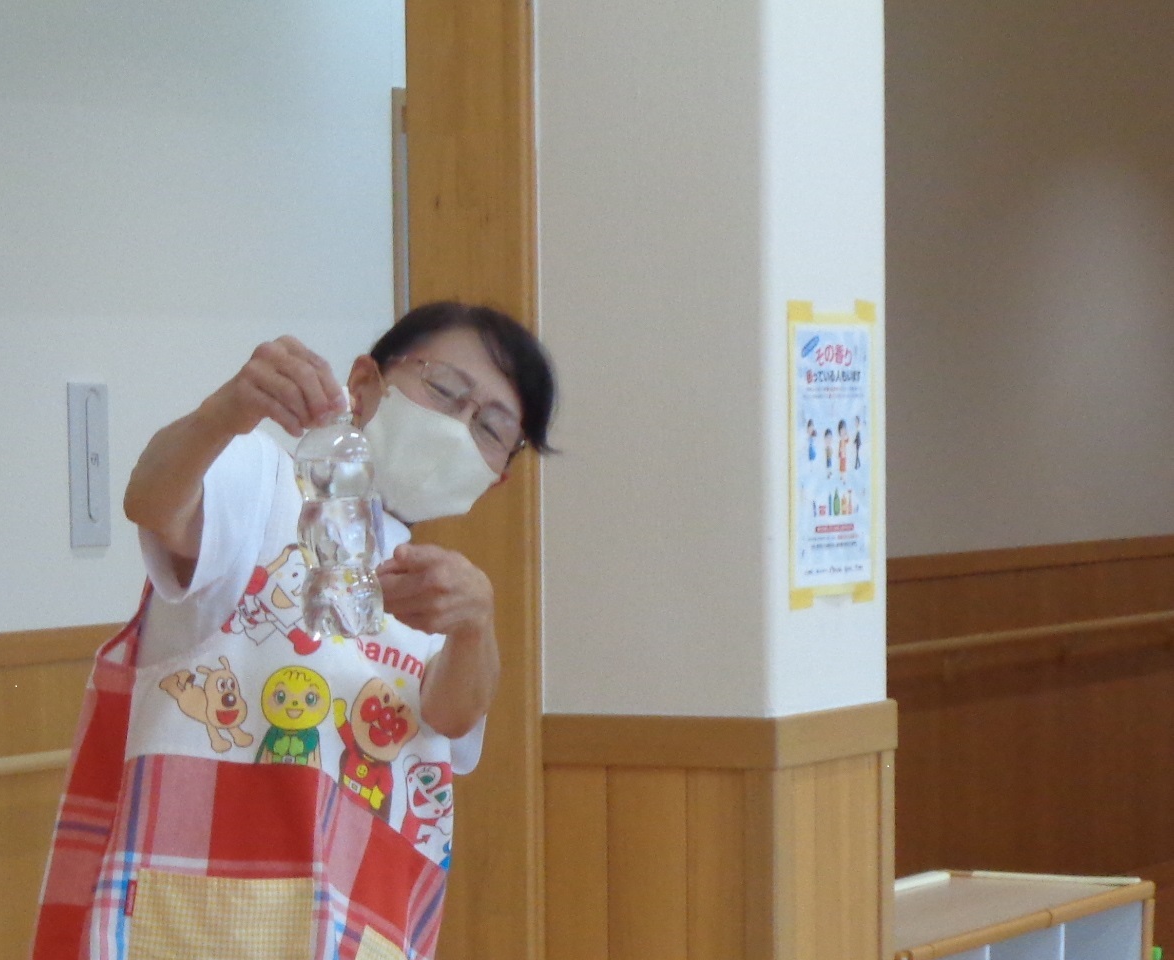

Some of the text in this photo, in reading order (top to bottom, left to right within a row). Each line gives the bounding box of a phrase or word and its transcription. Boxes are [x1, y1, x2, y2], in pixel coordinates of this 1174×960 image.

[816, 344, 852, 366] その香り
[356, 637, 424, 679] anm
